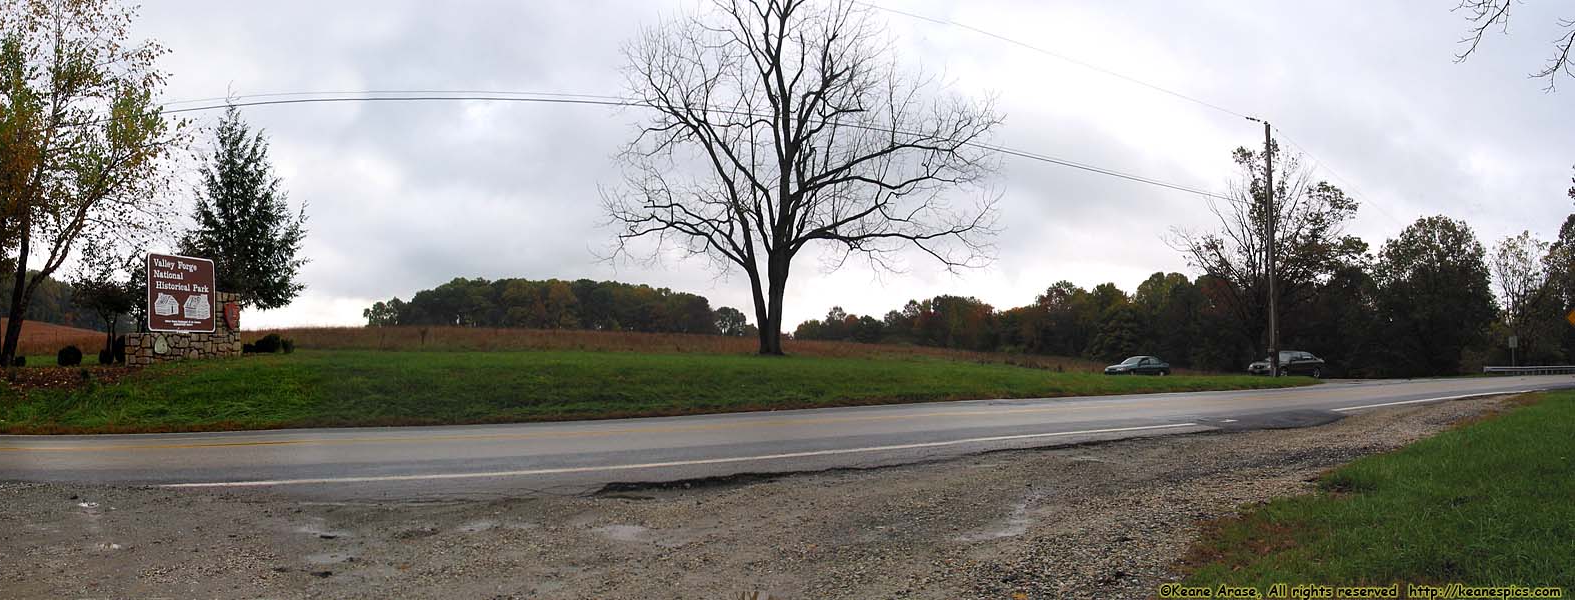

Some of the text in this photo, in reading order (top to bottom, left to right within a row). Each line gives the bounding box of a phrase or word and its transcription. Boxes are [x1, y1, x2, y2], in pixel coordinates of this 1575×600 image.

[153, 258, 198, 272] Valley Forge
[153, 270, 184, 280] National
[155, 281, 210, 293] Historical Park
